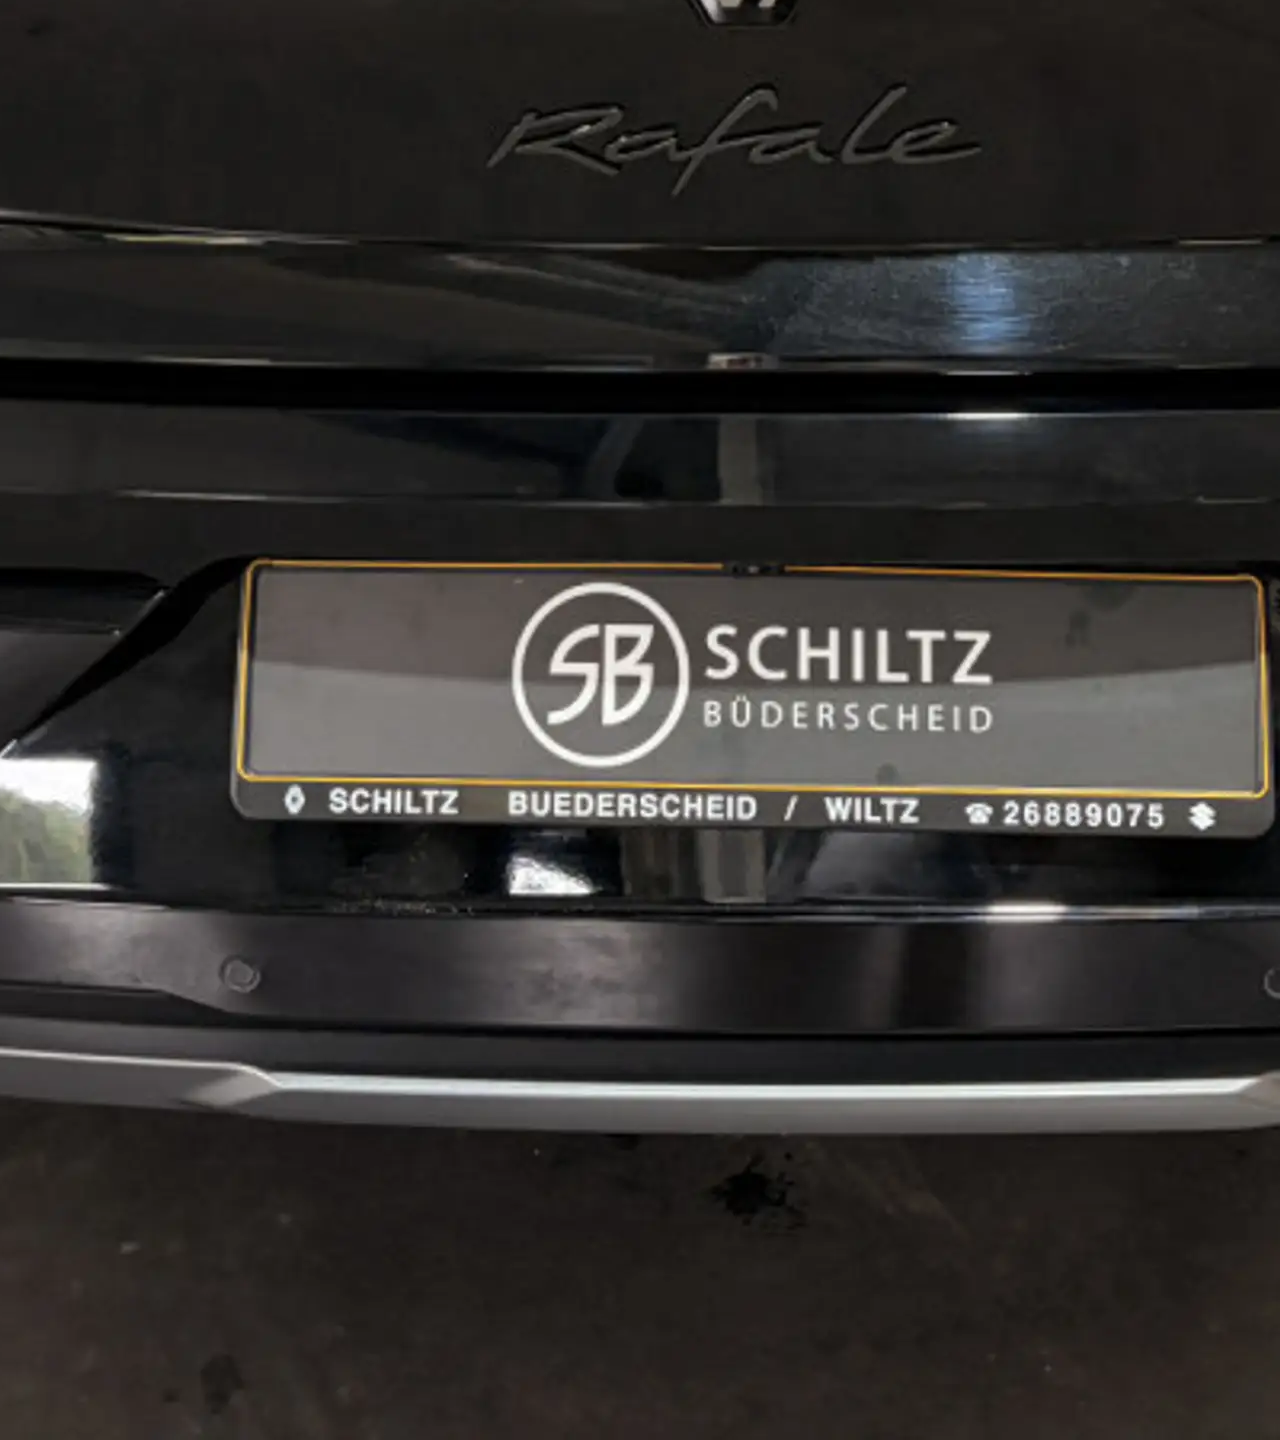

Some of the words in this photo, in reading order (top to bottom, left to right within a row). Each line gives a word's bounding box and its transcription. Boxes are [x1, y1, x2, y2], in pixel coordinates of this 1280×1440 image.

[487, 83, 982, 197] Rafale
[547, 623, 654, 727] SB
[703, 624, 993, 684] SCHILTZ
[702, 694, 994, 733] BÜDERSCHEID
[328, 787, 460, 816] SCHILTZ
[507, 790, 758, 821] BUEDERSCHEID
[783, 795, 799, 822] /
[824, 795, 920, 825] WILTZ
[1002, 800, 1165, 829] 26889075
